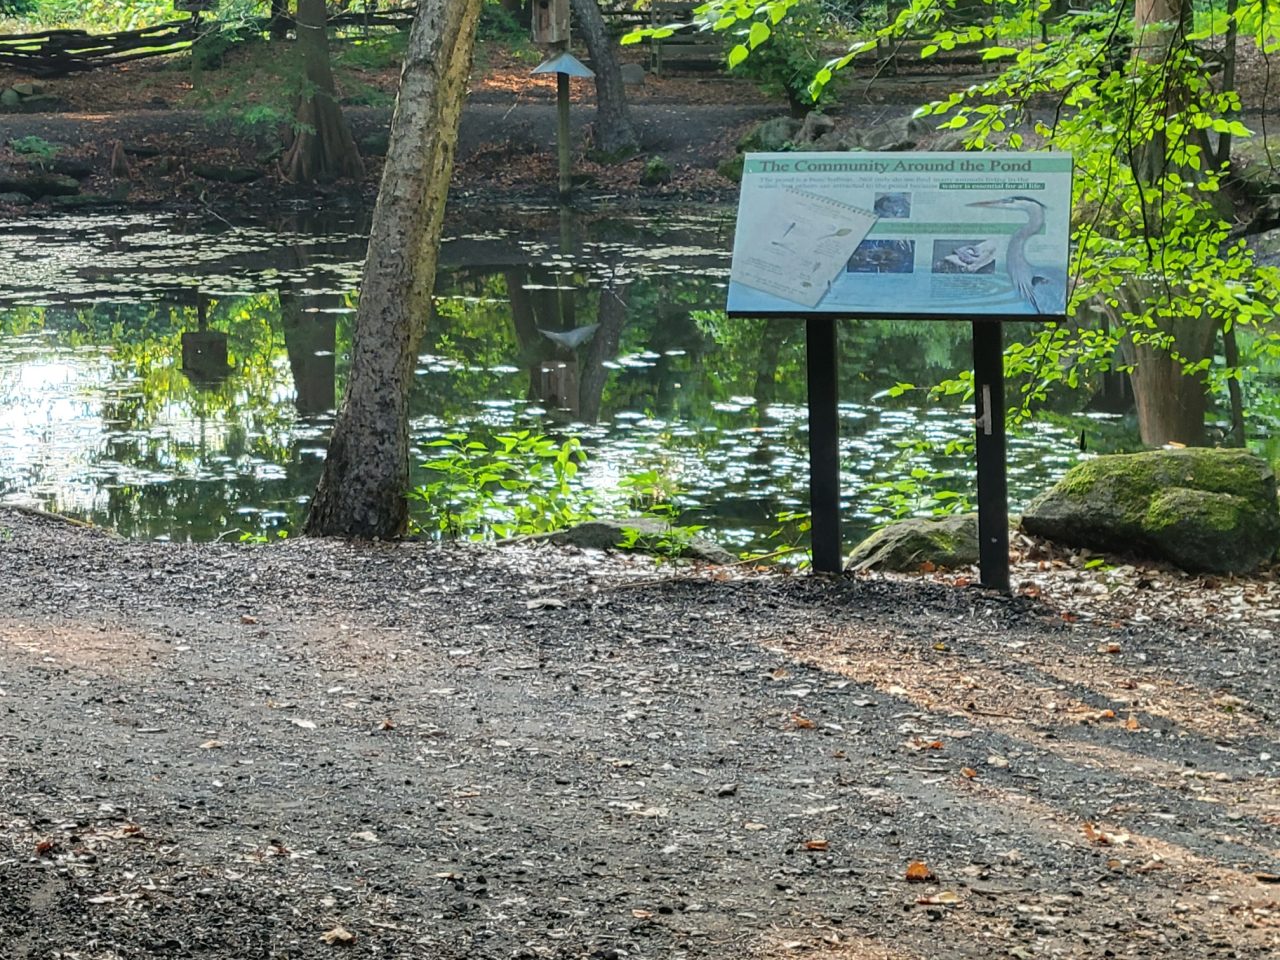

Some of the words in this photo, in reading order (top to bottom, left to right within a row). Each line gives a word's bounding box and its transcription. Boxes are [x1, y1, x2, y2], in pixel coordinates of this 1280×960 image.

[759, 160, 790, 172] The
[794, 160, 889, 174] Community
[894, 160, 955, 172] Around
[960, 160, 985, 172] the
[990, 160, 1032, 172] Pond
